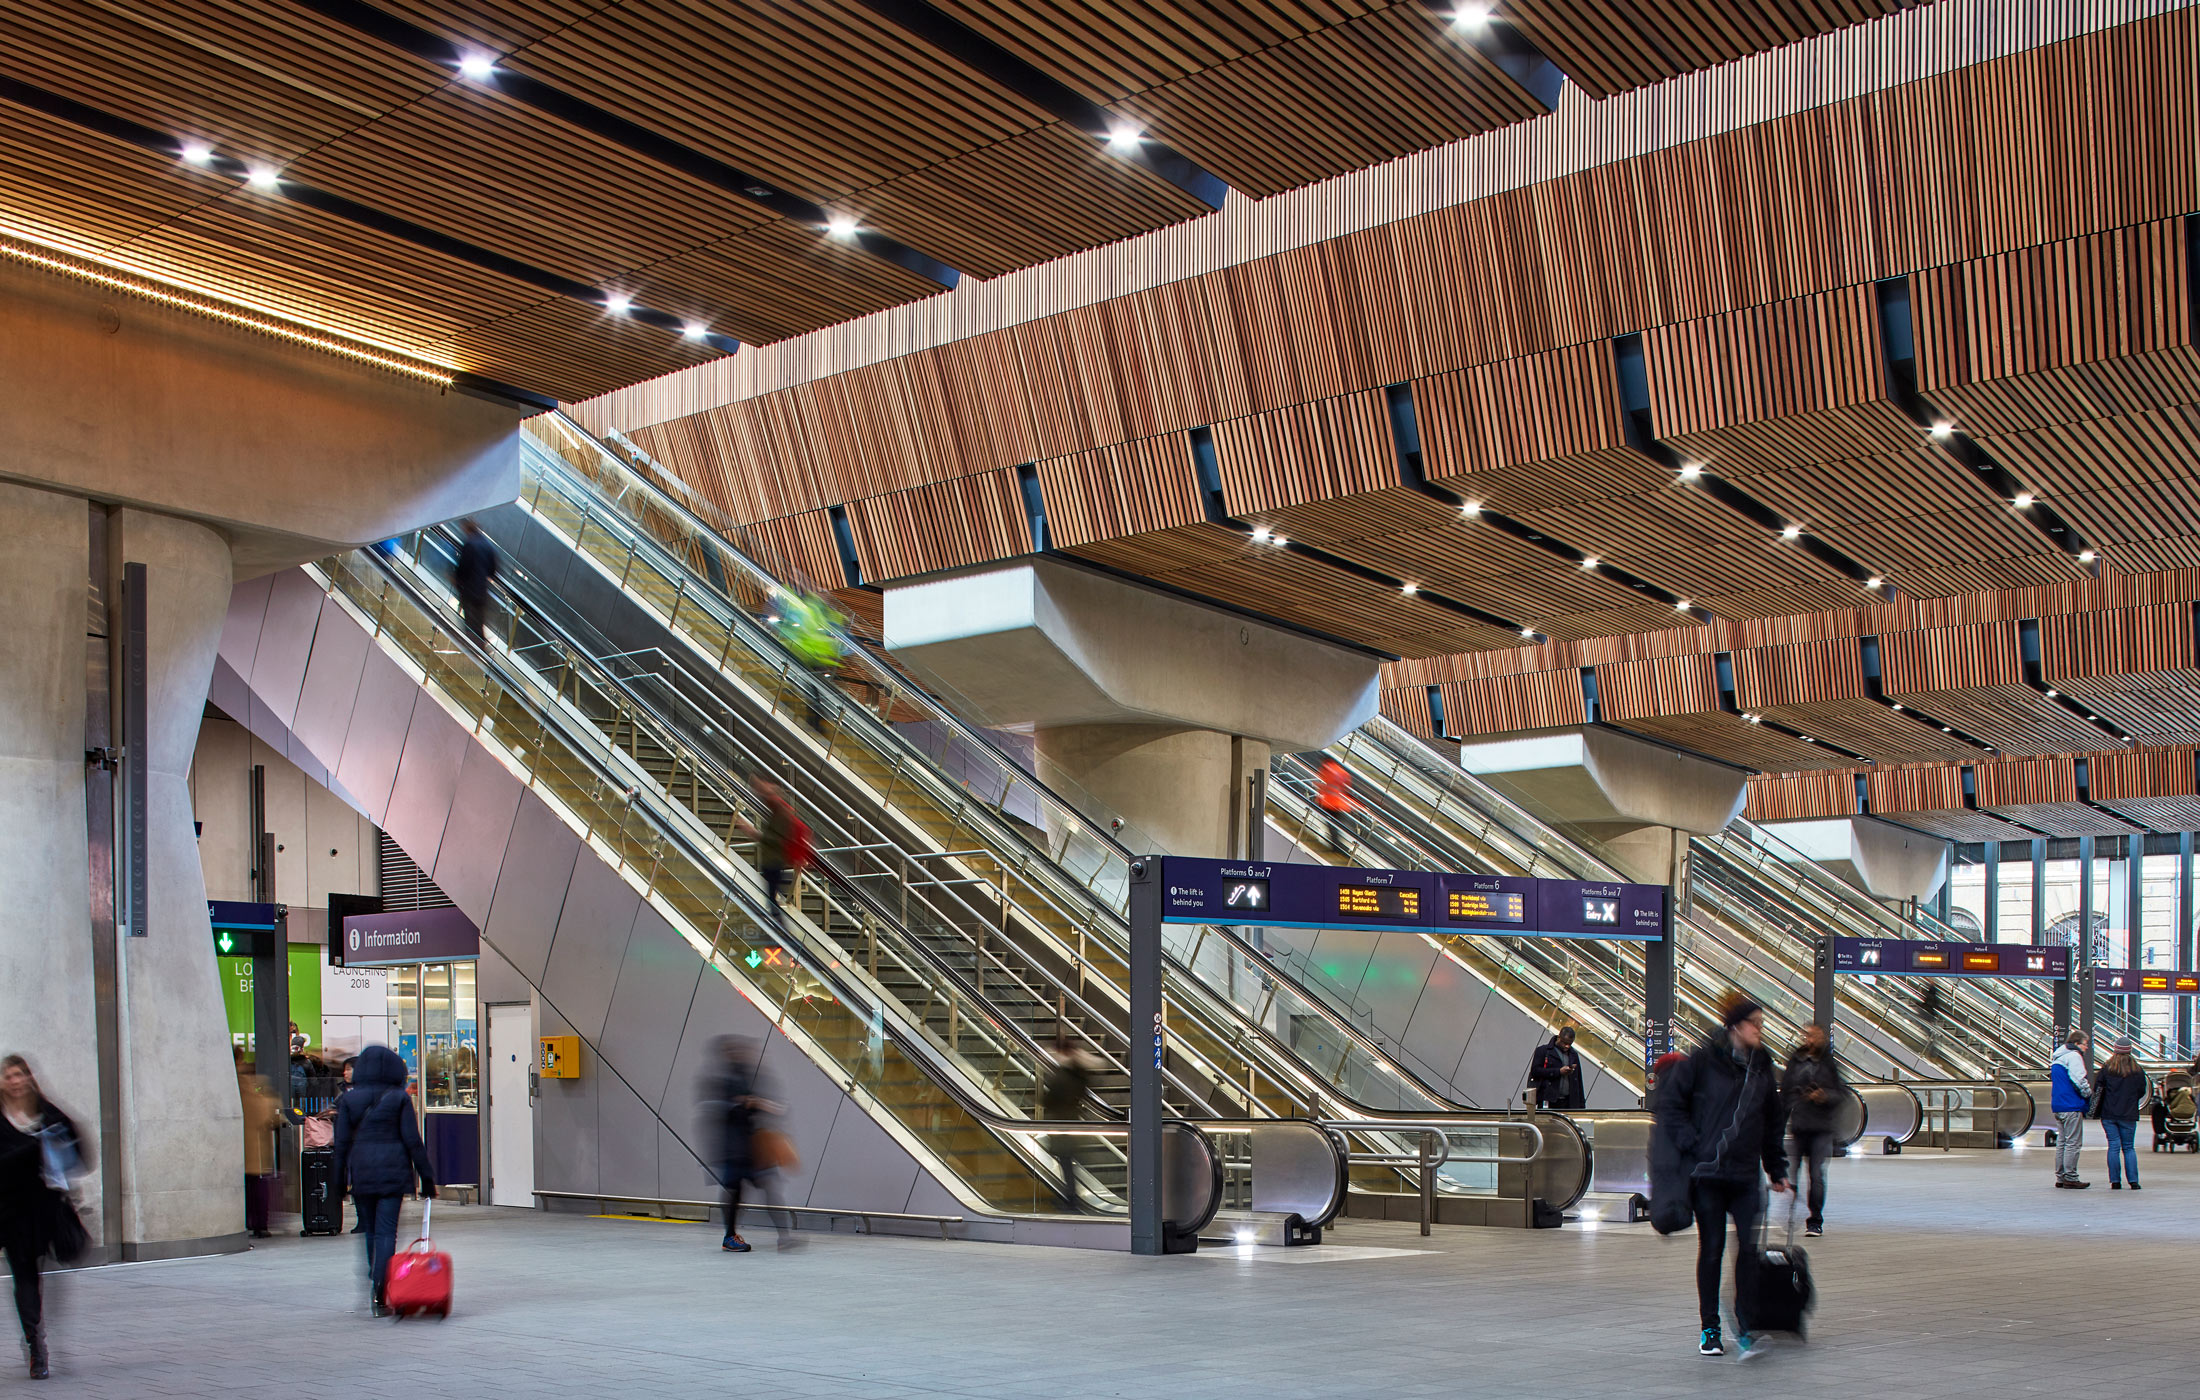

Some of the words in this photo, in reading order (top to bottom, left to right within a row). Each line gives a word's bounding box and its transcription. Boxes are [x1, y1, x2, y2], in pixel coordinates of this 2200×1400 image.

[1220, 868, 1246, 876] Platforms
[1248, 866, 1254, 876] 6
[1265, 867, 1271, 877] 7
[1366, 876, 1388, 884] Platform
[1388, 874, 1394, 884] 7
[1474, 882, 1494, 890] Platform
[1495, 880, 1500, 890] 6
[1189, 888, 1198, 896] lift
[1582, 888, 1602, 896] Platforms
[1602, 886, 1607, 896] 6
[1617, 887, 1622, 897] 7
[1192, 900, 1204, 908] you
[1586, 911, 1602, 920] Entry
[364, 928, 421, 947] Information
[334, 967, 387, 977] LAUNCHING
[351, 979, 370, 989] 2018
